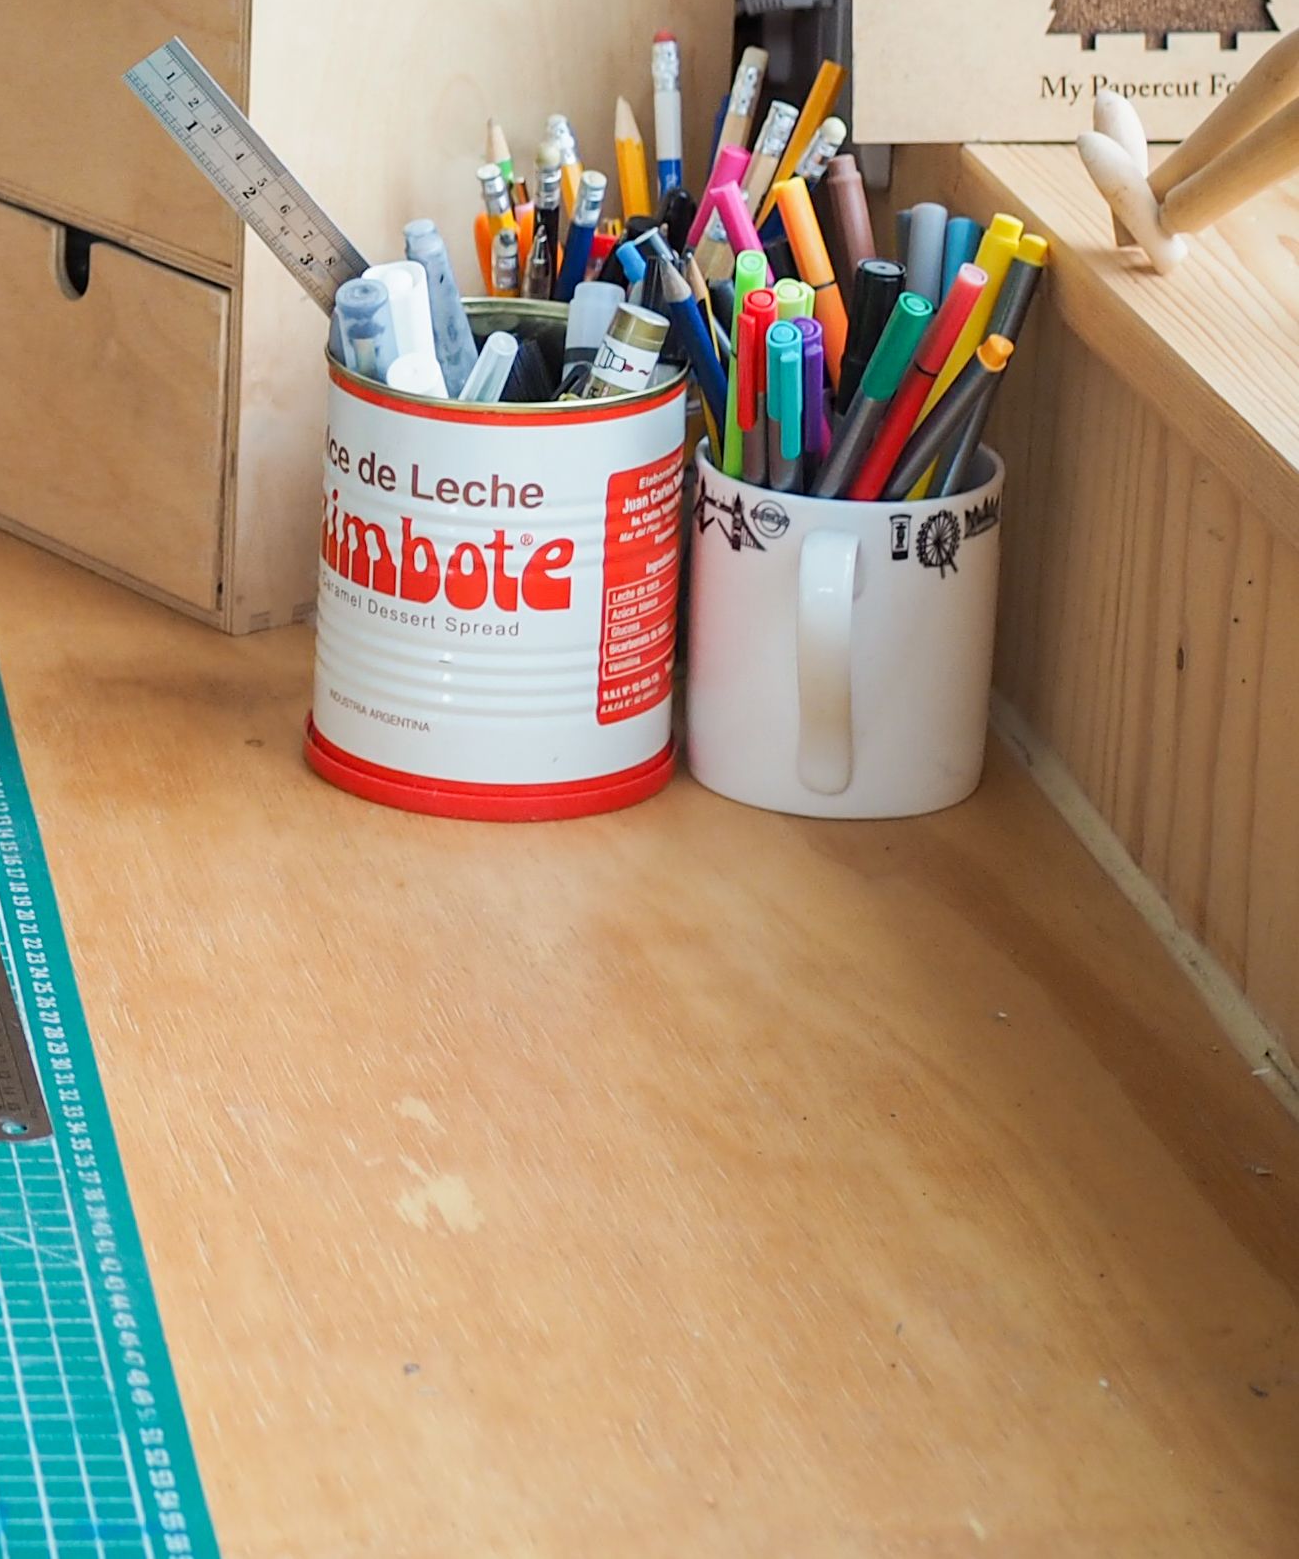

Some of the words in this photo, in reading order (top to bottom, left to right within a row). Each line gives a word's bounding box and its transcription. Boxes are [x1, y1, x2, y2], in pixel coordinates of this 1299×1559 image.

[1040, 74, 1083, 106] My
[1091, 73, 1201, 99] Papercut
[325, 424, 350, 475] lce
[358, 451, 397, 492] de
[411, 463, 545, 509] Leche
[622, 494, 650, 515] Juan
[321, 488, 575, 613] imbote
[367, 598, 437, 630] Dessert
[444, 616, 520, 637] Spread
[369, 707, 431, 733] ARGENTINA
[0, 841, 19, 852] 15
[2, 854, 23, 866] 16
[5, 867, 26, 879] 17
[8, 881, 29, 893] 18
[12, 895, 33, 907] 19
[15, 909, 36, 921] 20
[18, 923, 39, 935] 21
[22, 937, 43, 950] 22
[25, 951, 47, 964] 23
[29, 966, 50, 979] 24
[32, 981, 54, 994] 25
[35, 995, 57, 1009] 26
[39, 1011, 61, 1024] 27
[42, 1026, 66, 1039] 28
[46, 1041, 69, 1055] 29
[50, 1057, 73, 1070] 30
[54, 1073, 75, 1085] 31
[58, 1088, 80, 1102] 32
[62, 1104, 85, 1118] 33
[66, 1121, 87, 1135] 34
[70, 1137, 93, 1151] 35
[74, 1154, 96, 1168] 36
[77, 1170, 102, 1184] 37
[82, 1187, 106, 1202] 38
